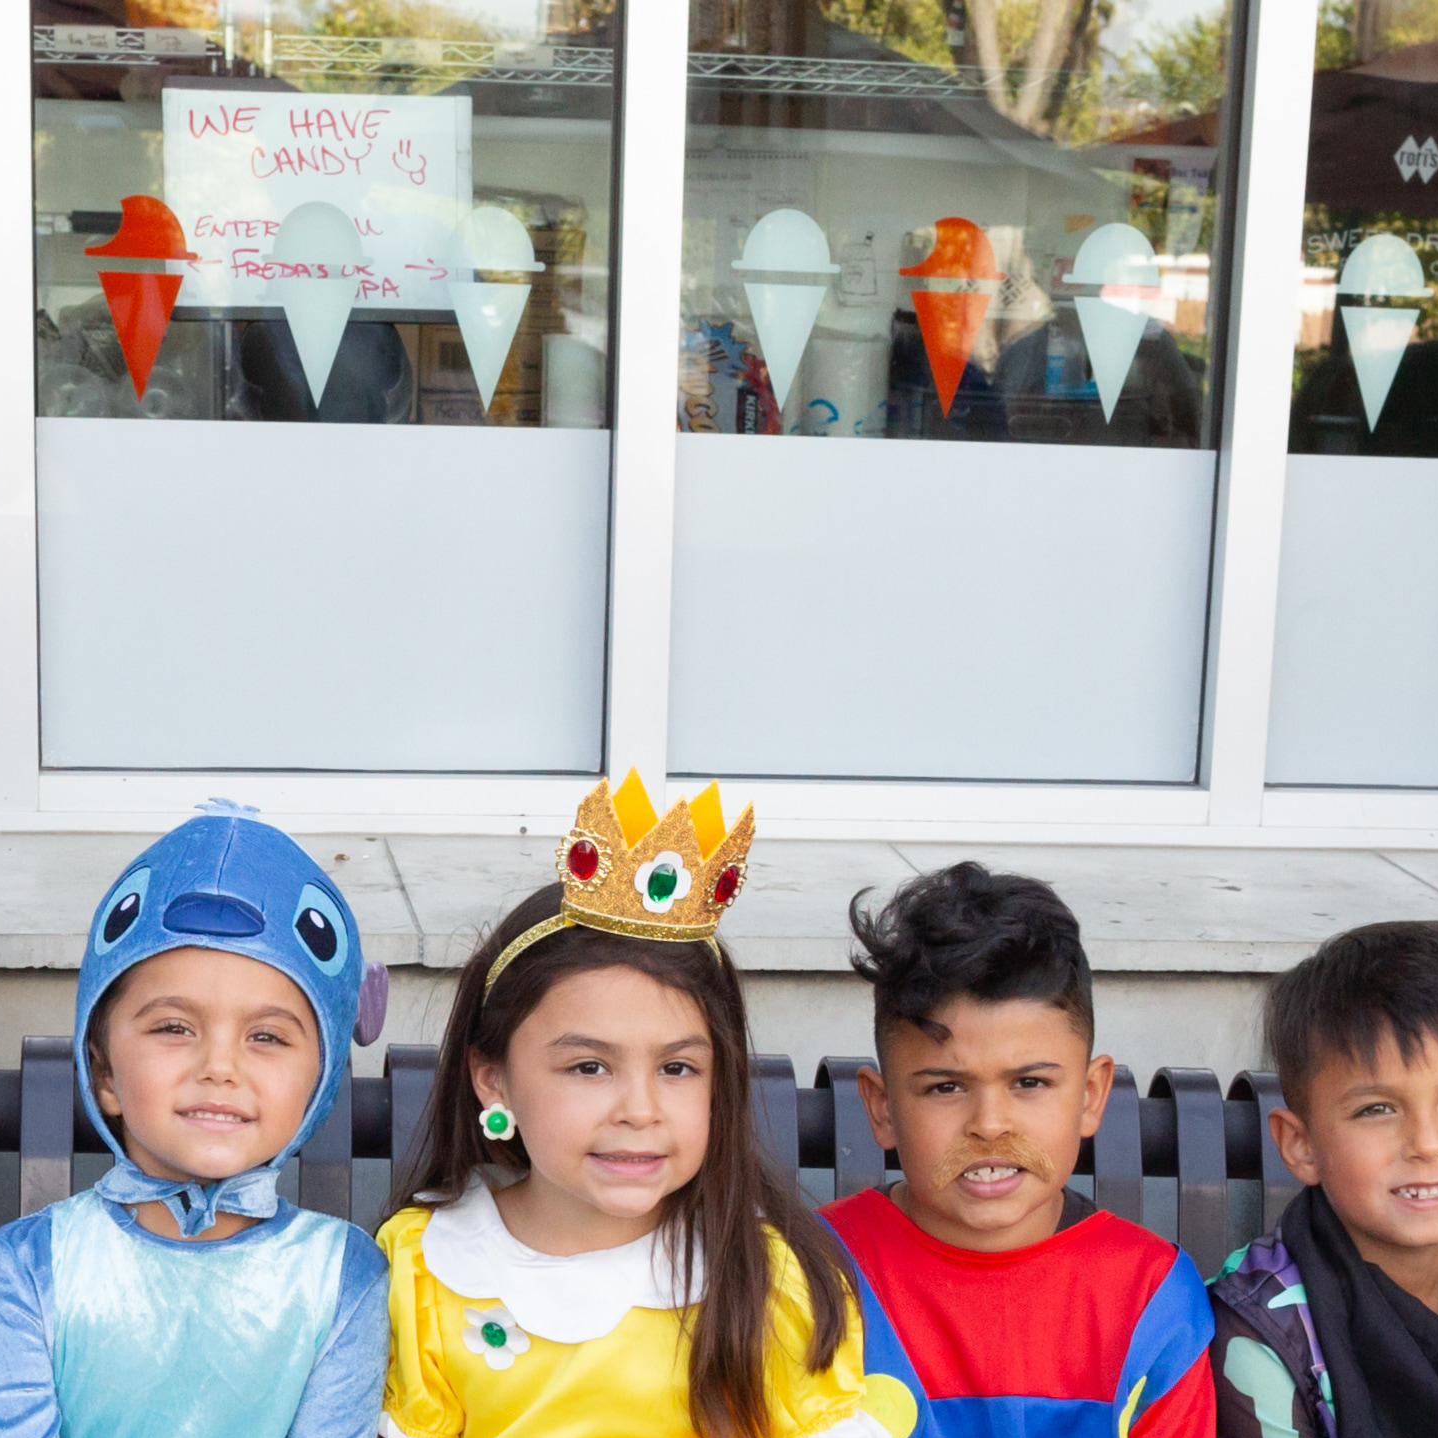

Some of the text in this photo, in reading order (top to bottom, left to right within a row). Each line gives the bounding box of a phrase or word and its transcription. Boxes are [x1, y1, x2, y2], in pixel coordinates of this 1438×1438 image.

[189, 105, 391, 141] WE HAVE
[251, 143, 372, 179] CANDY
[194, 215, 281, 238] ENTER
[745, 393, 758, 434] KIRK
